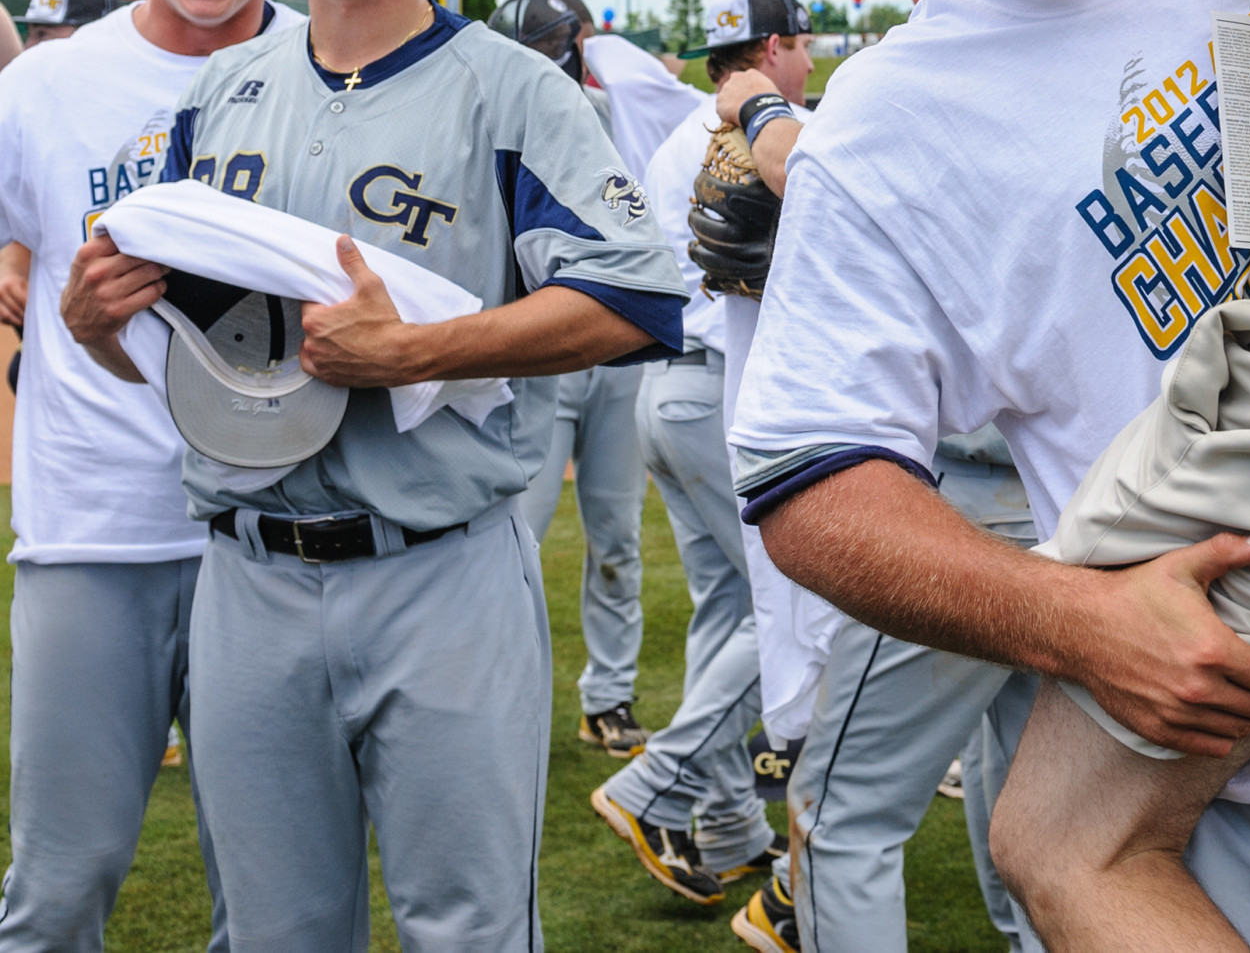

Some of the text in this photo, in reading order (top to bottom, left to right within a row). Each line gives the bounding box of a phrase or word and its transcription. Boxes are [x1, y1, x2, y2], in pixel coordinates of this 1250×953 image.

[1121, 59, 1208, 144] 2012
[347, 163, 459, 248] GT
[1111, 156, 1240, 361] CHA
[754, 751, 791, 779] GT
